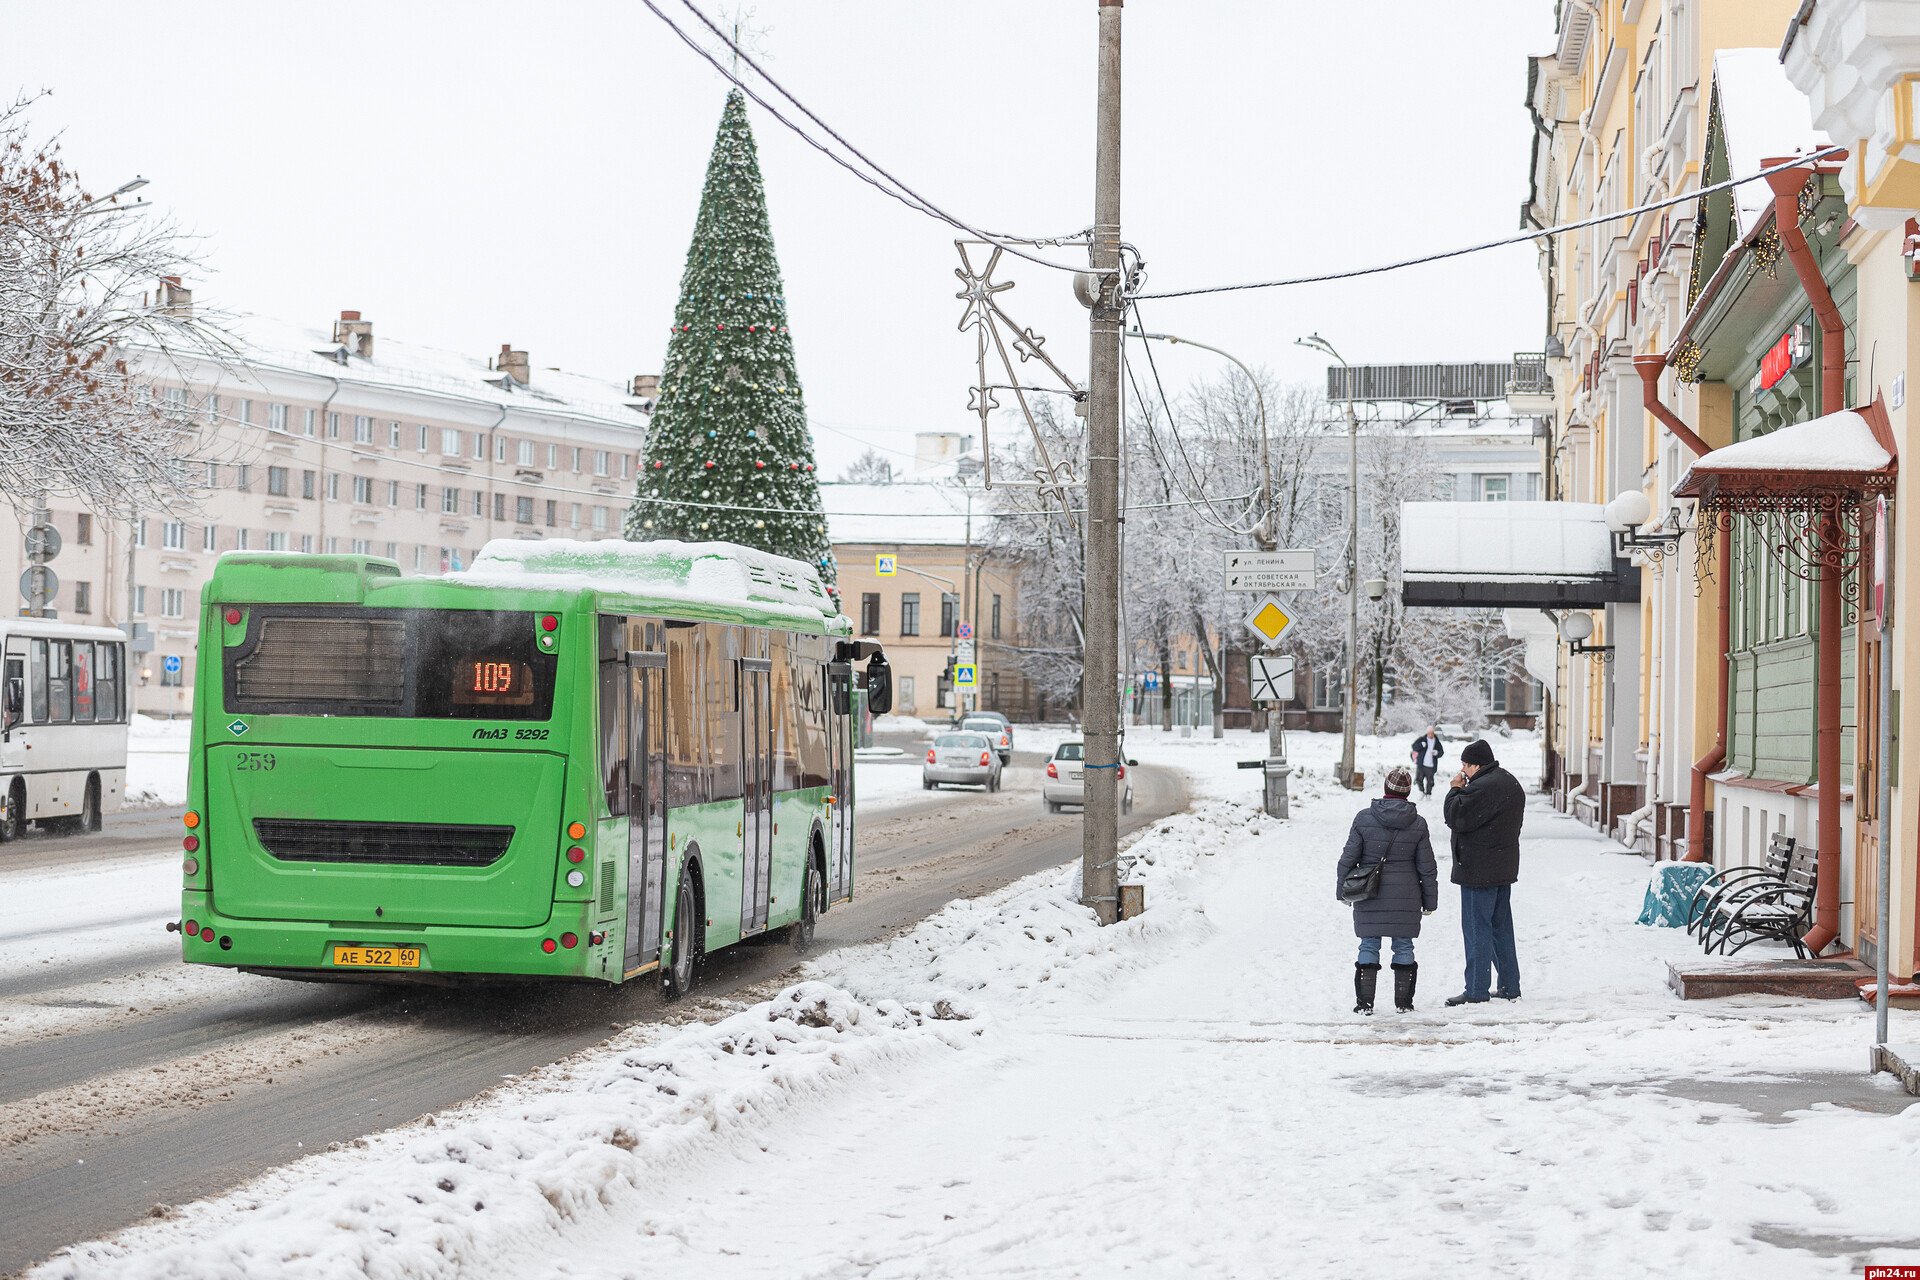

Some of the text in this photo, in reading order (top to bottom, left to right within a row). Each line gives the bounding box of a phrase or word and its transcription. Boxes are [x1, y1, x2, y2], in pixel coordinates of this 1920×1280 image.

[474, 663, 511, 692] 109
[515, 729, 550, 740] 5292
[237, 752, 276, 771] 259
[365, 950, 392, 964] 522
[400, 950, 415, 961] 60
